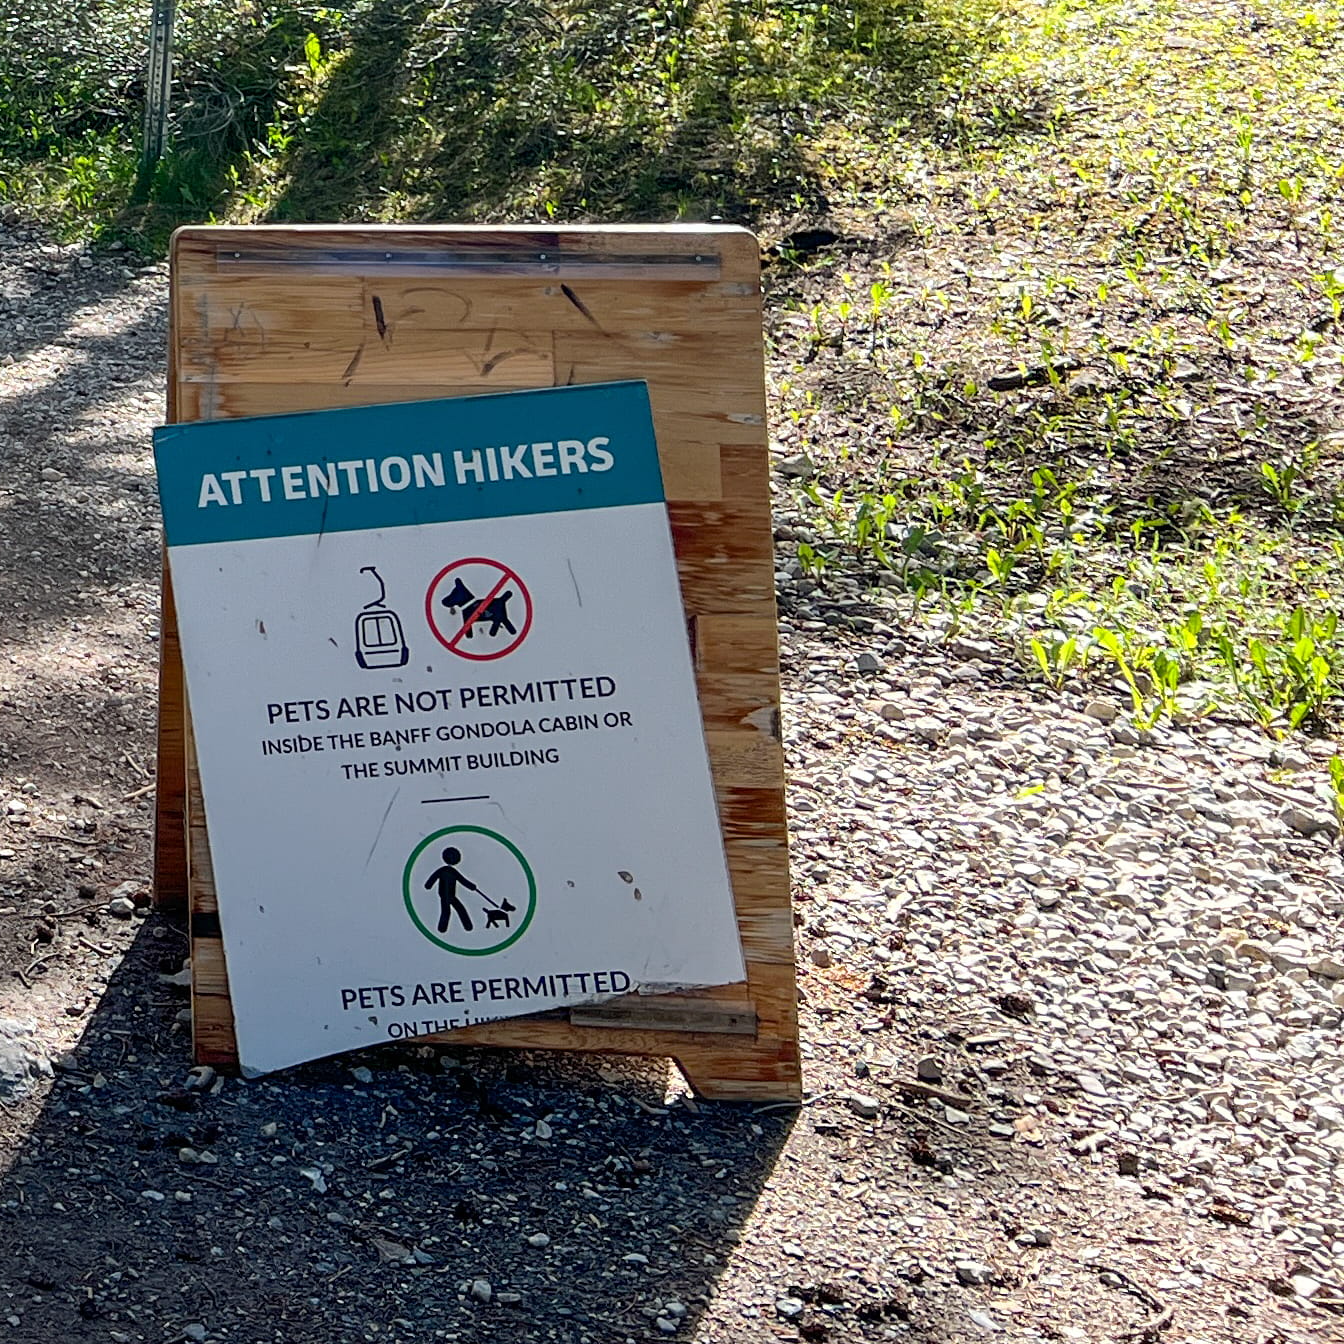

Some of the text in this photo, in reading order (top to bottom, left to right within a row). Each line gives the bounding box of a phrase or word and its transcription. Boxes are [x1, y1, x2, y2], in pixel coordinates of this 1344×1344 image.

[197, 436, 614, 508] ATTENTION HIKERS
[267, 676, 616, 724] PETS ARE NOT PERMITTED
[262, 711, 633, 755] INSIDE THE BANFF GONDOLA CABIN OR
[341, 748, 560, 780] THE SUMMIT BUILDING
[341, 970, 631, 1010] PETS ARE PERMITTED
[387, 1021, 418, 1038] ON
